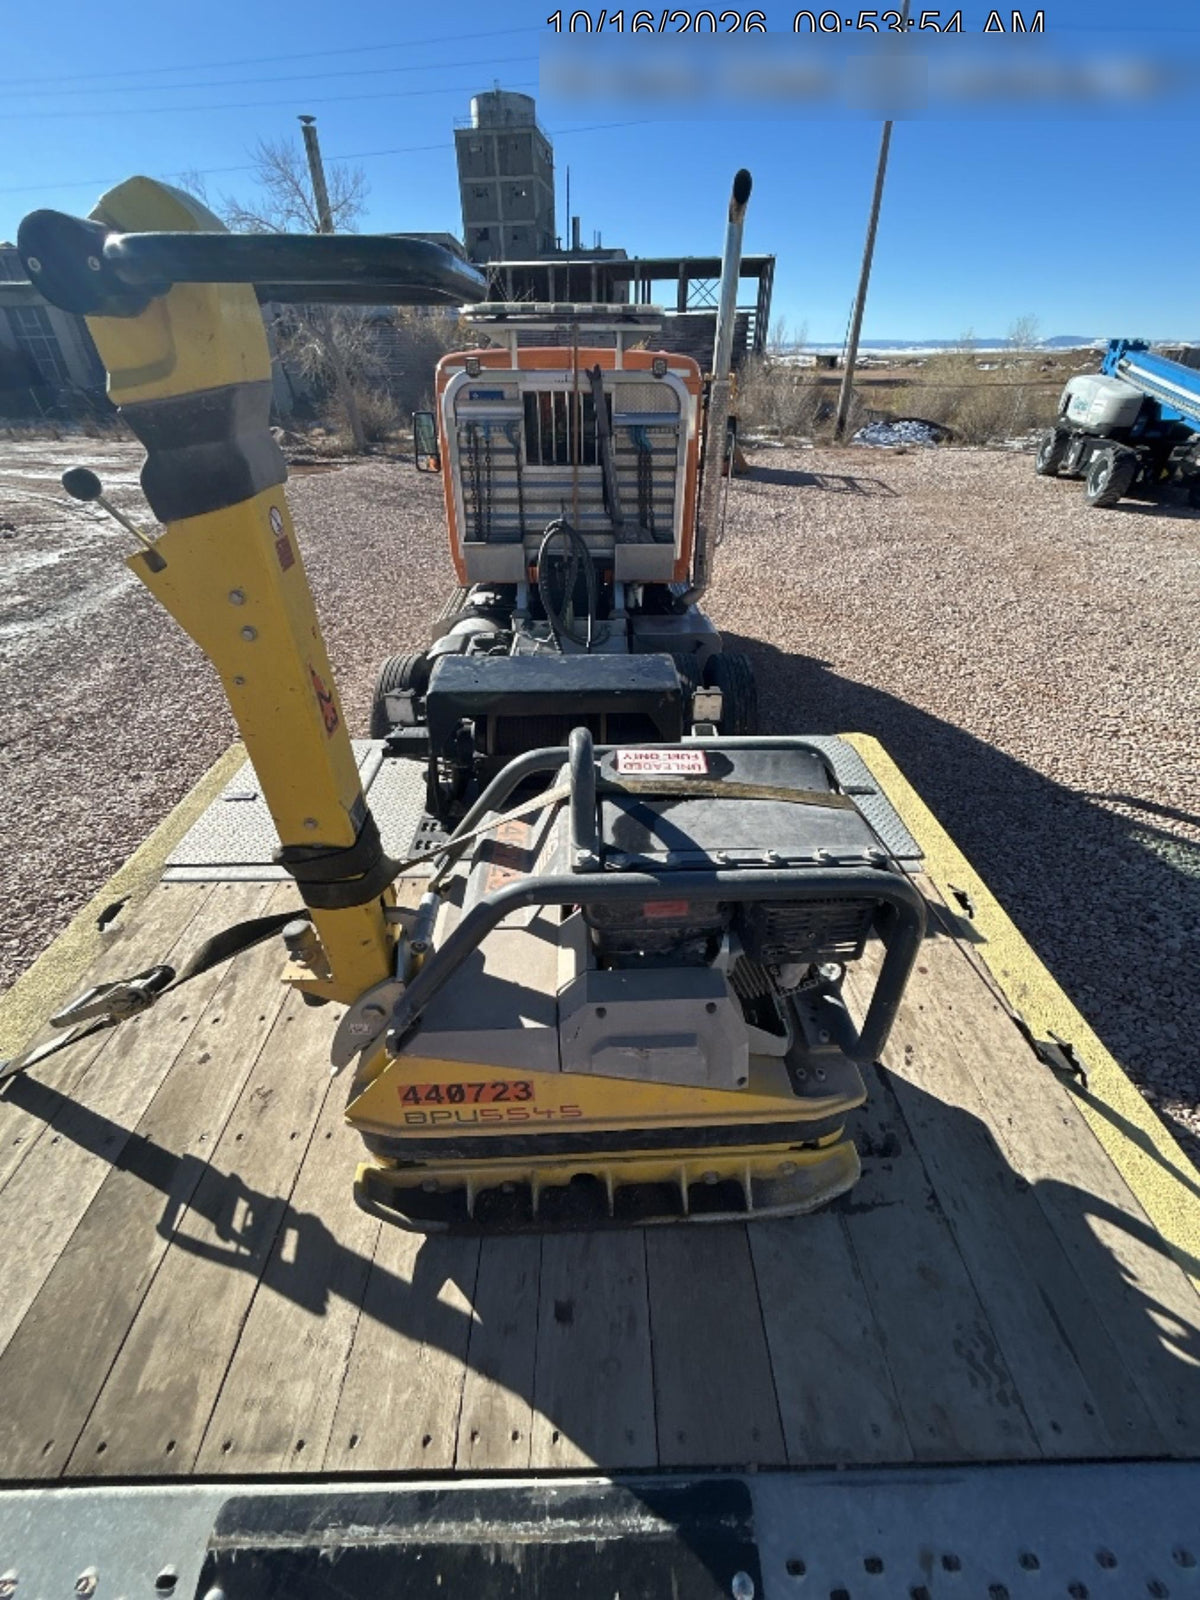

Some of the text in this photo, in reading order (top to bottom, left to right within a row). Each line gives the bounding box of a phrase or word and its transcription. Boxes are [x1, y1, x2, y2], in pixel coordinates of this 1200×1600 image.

[623, 753, 699, 761] FUEL ONLY
[623, 762, 702, 771] UNLEADED
[402, 1081, 533, 1104] 440723
[404, 1105, 582, 1124] BPU5545
